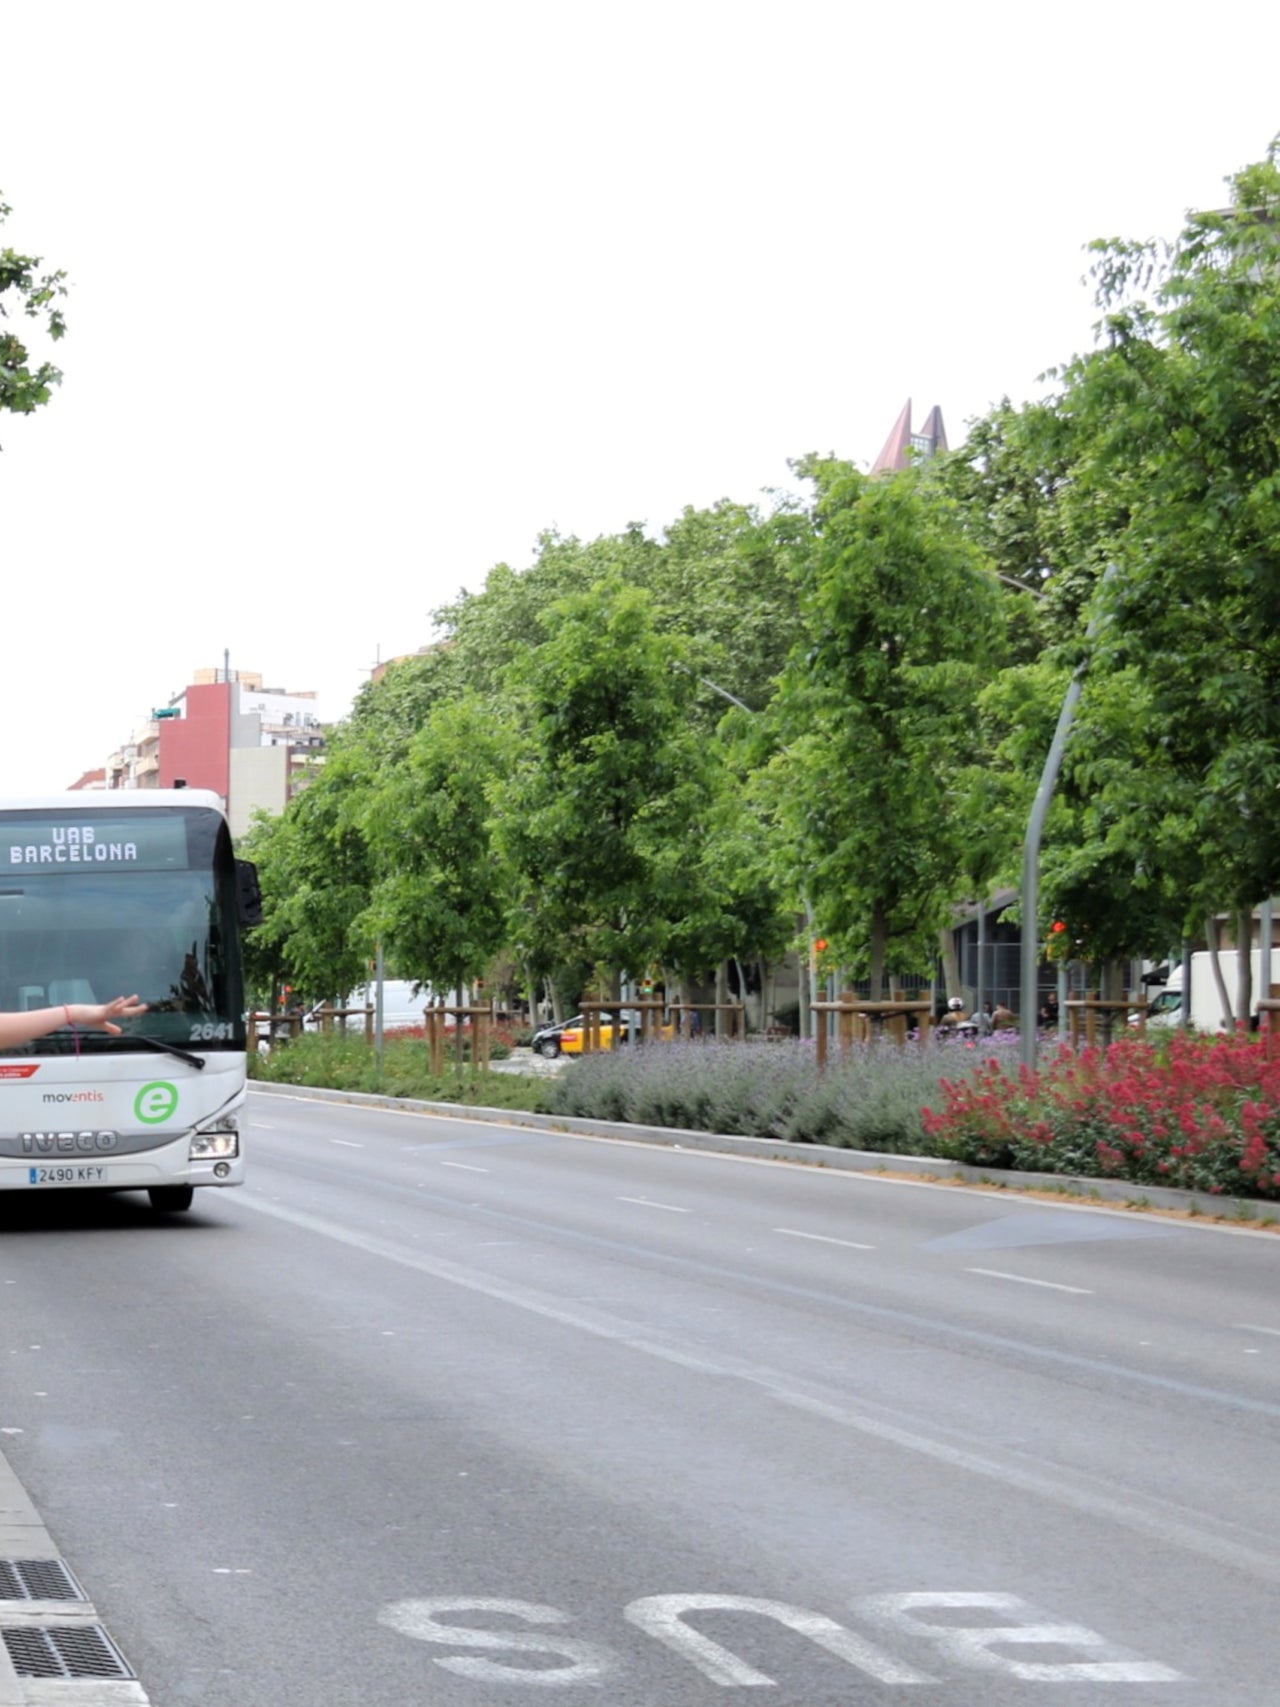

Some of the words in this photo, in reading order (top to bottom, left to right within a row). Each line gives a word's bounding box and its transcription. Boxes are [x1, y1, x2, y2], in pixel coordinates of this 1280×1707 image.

[52, 826, 95, 844] UAB
[10, 842, 137, 864] BARCELONA
[189, 1022, 234, 1041] 2641
[43, 1090, 104, 1103] moventis
[22, 1131, 118, 1152] IVECO
[40, 1168, 74, 1182] 2490
[78, 1167, 103, 1180] KFY
